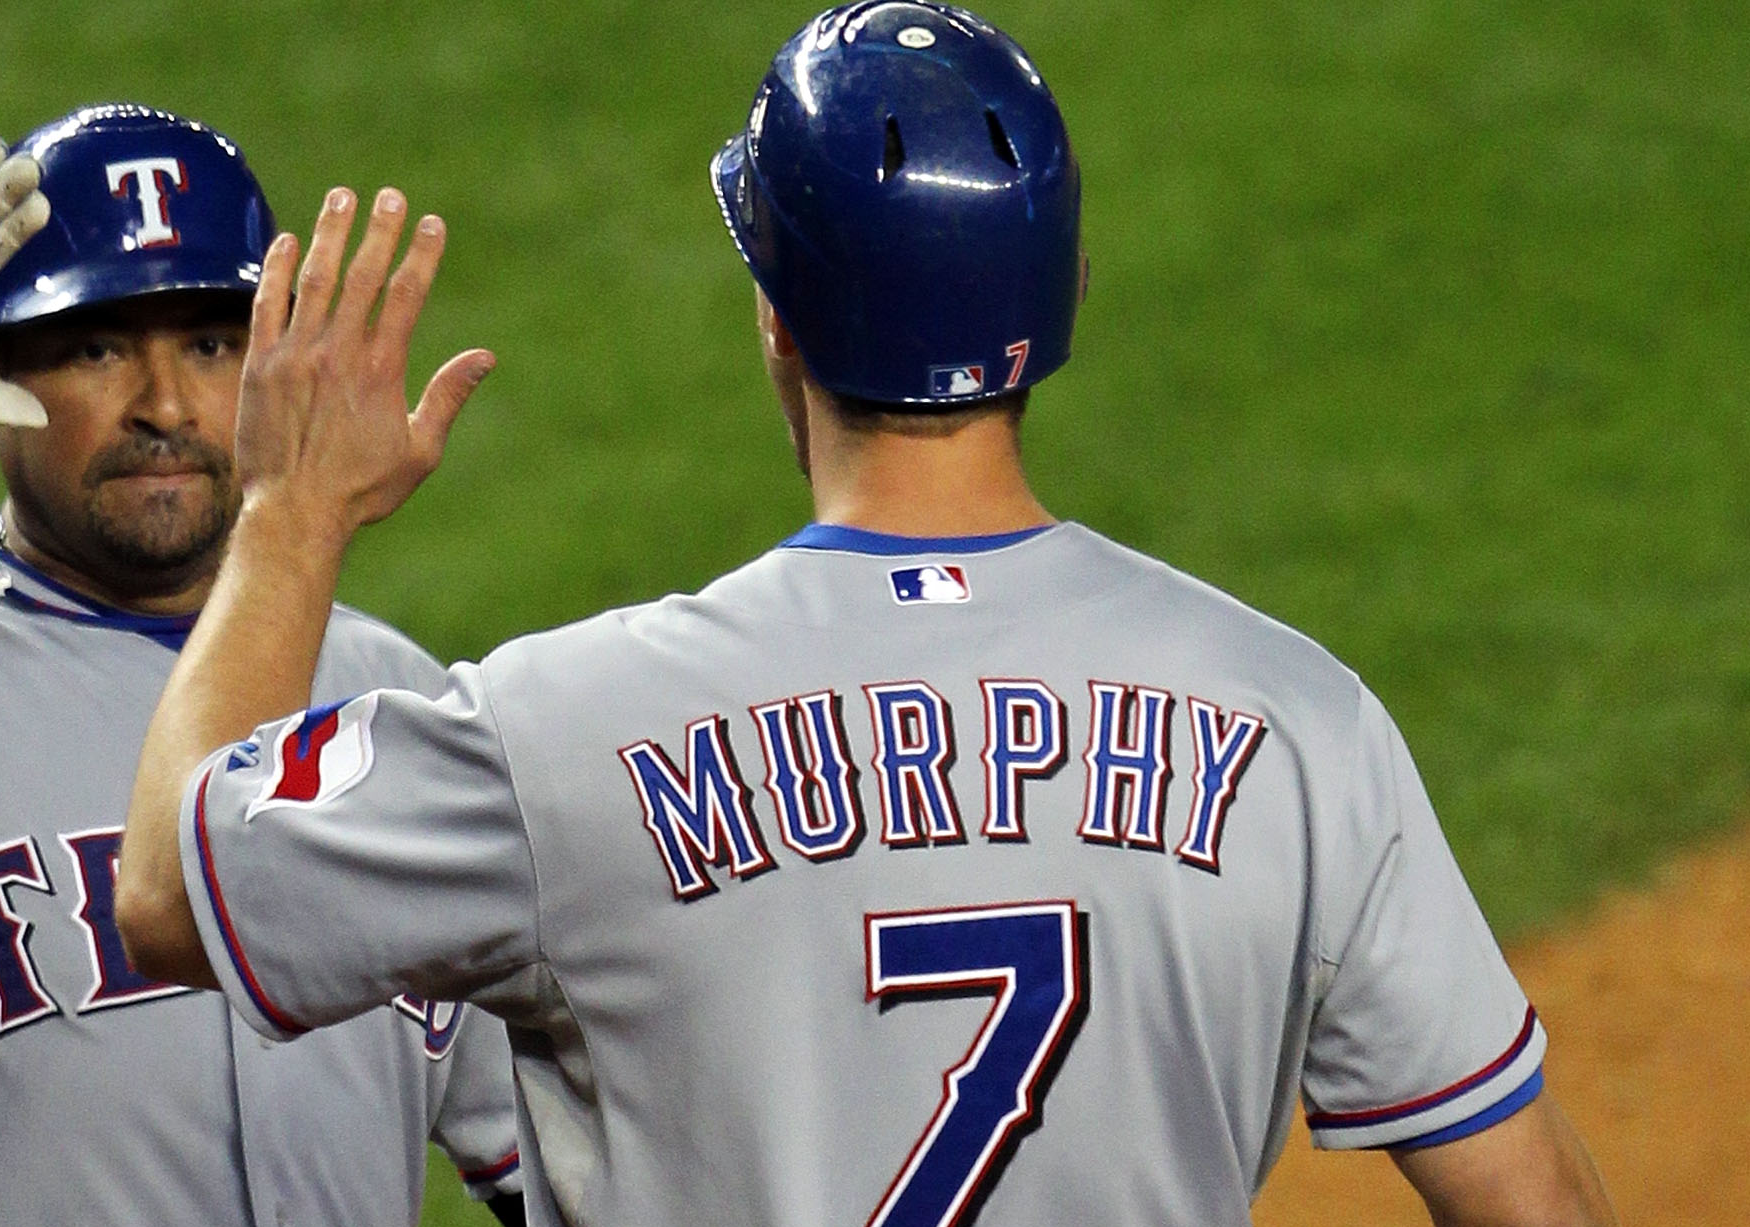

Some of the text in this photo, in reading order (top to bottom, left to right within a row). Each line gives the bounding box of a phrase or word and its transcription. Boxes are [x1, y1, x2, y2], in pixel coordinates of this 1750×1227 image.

[105, 157, 188, 249] T
[1006, 339, 1030, 388] 7
[618, 678, 1268, 902] MURPHY
